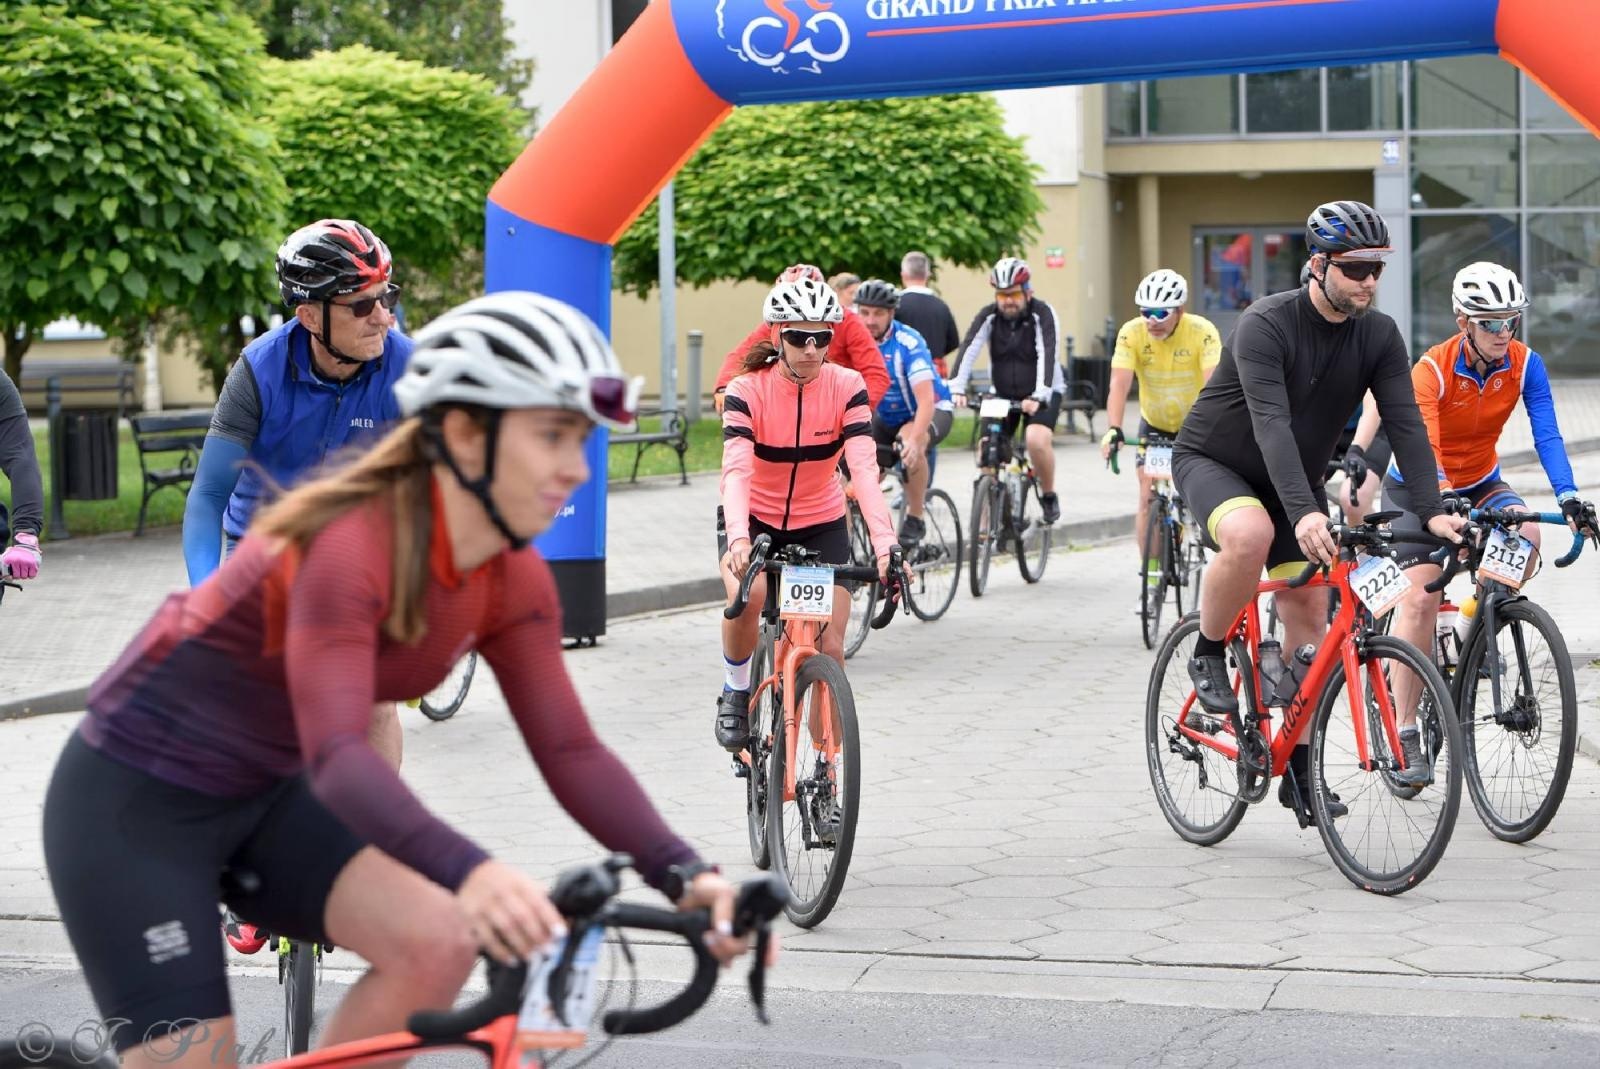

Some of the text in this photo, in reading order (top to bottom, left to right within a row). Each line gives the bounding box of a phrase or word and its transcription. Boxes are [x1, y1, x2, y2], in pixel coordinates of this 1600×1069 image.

[1487, 544, 1526, 570] 2112
[790, 584, 825, 601] 099
[1359, 564, 1401, 601] 2222
